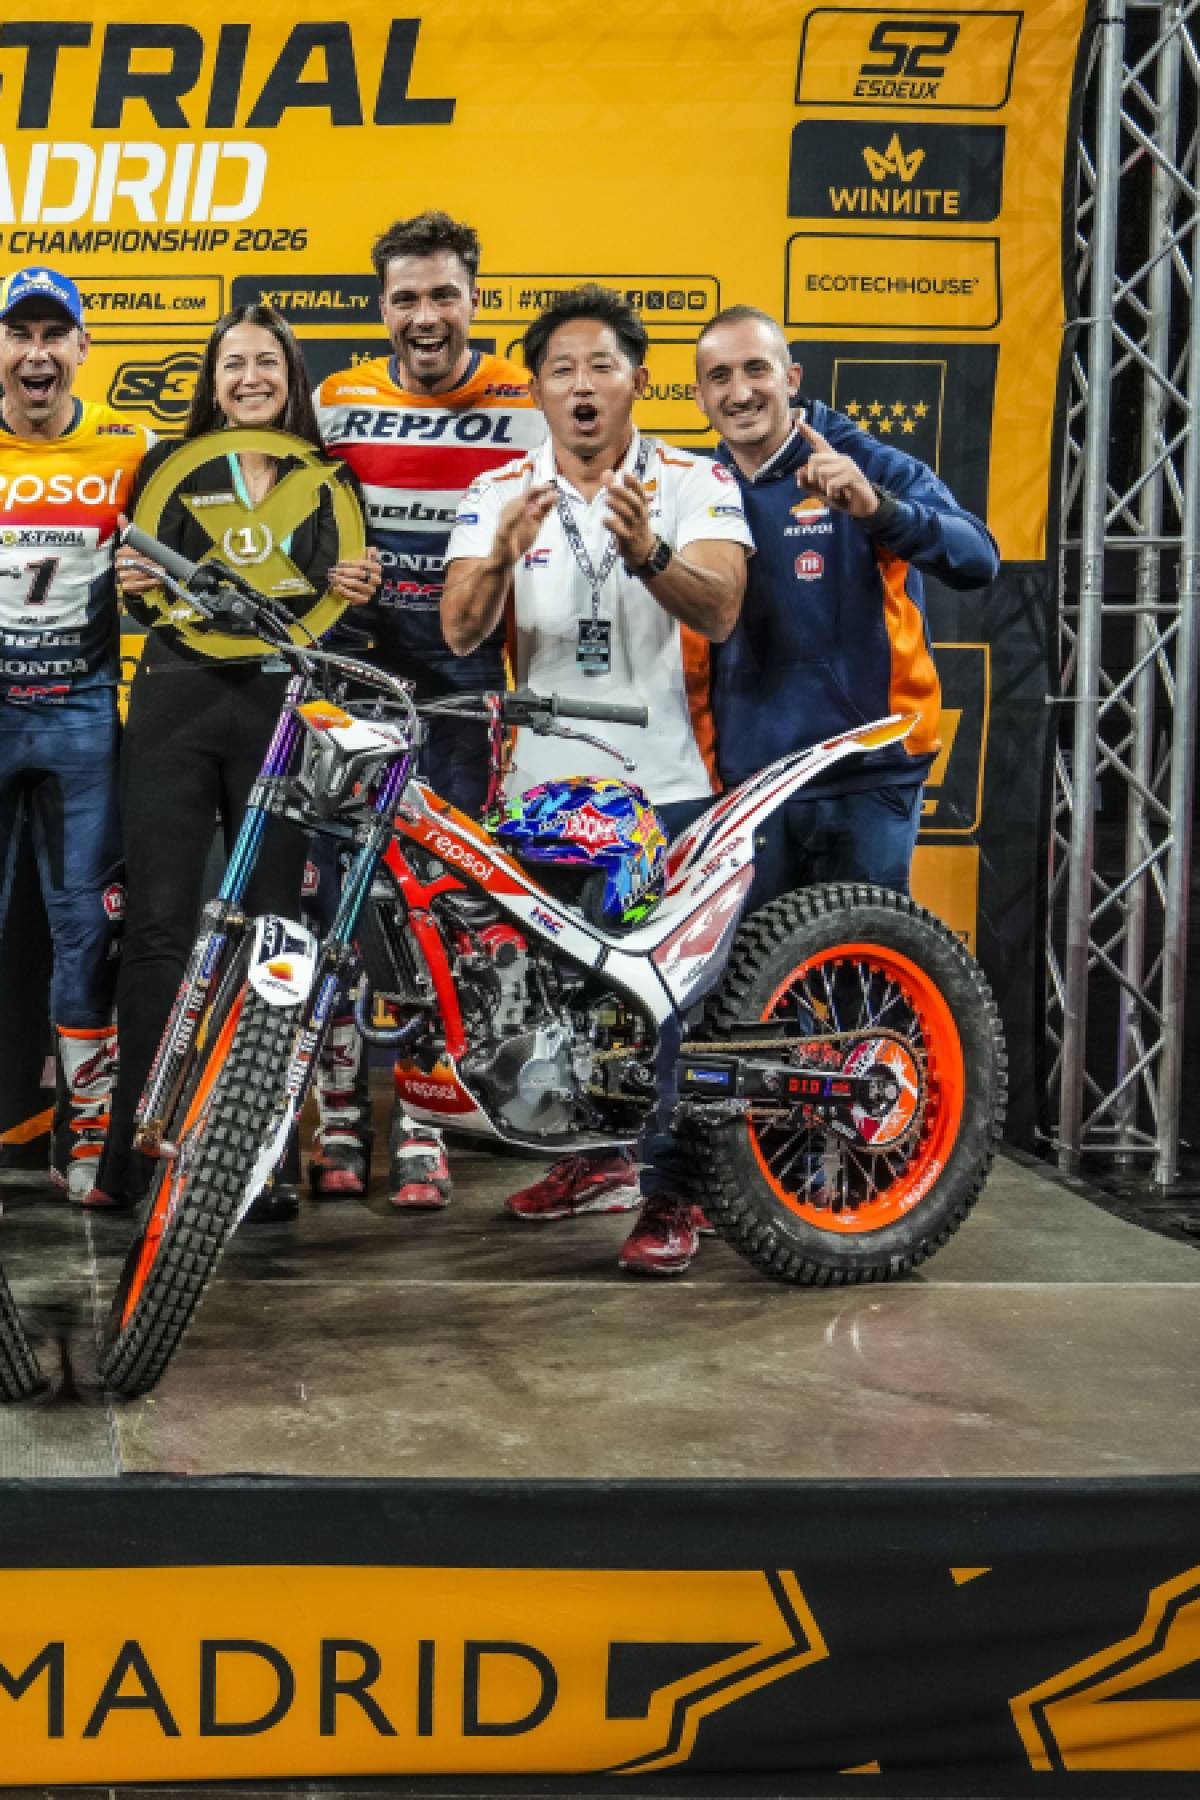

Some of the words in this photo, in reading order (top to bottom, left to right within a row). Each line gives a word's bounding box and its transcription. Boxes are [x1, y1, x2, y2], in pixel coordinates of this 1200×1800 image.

[9, 229, 230, 255] CHAMPIONSHIP
[232, 228, 308, 251] 2026
[805, 274, 975, 295] ECOTECHHOUSE
[343, 410, 513, 444] REPSOL
[423, 829, 494, 881] repsol
